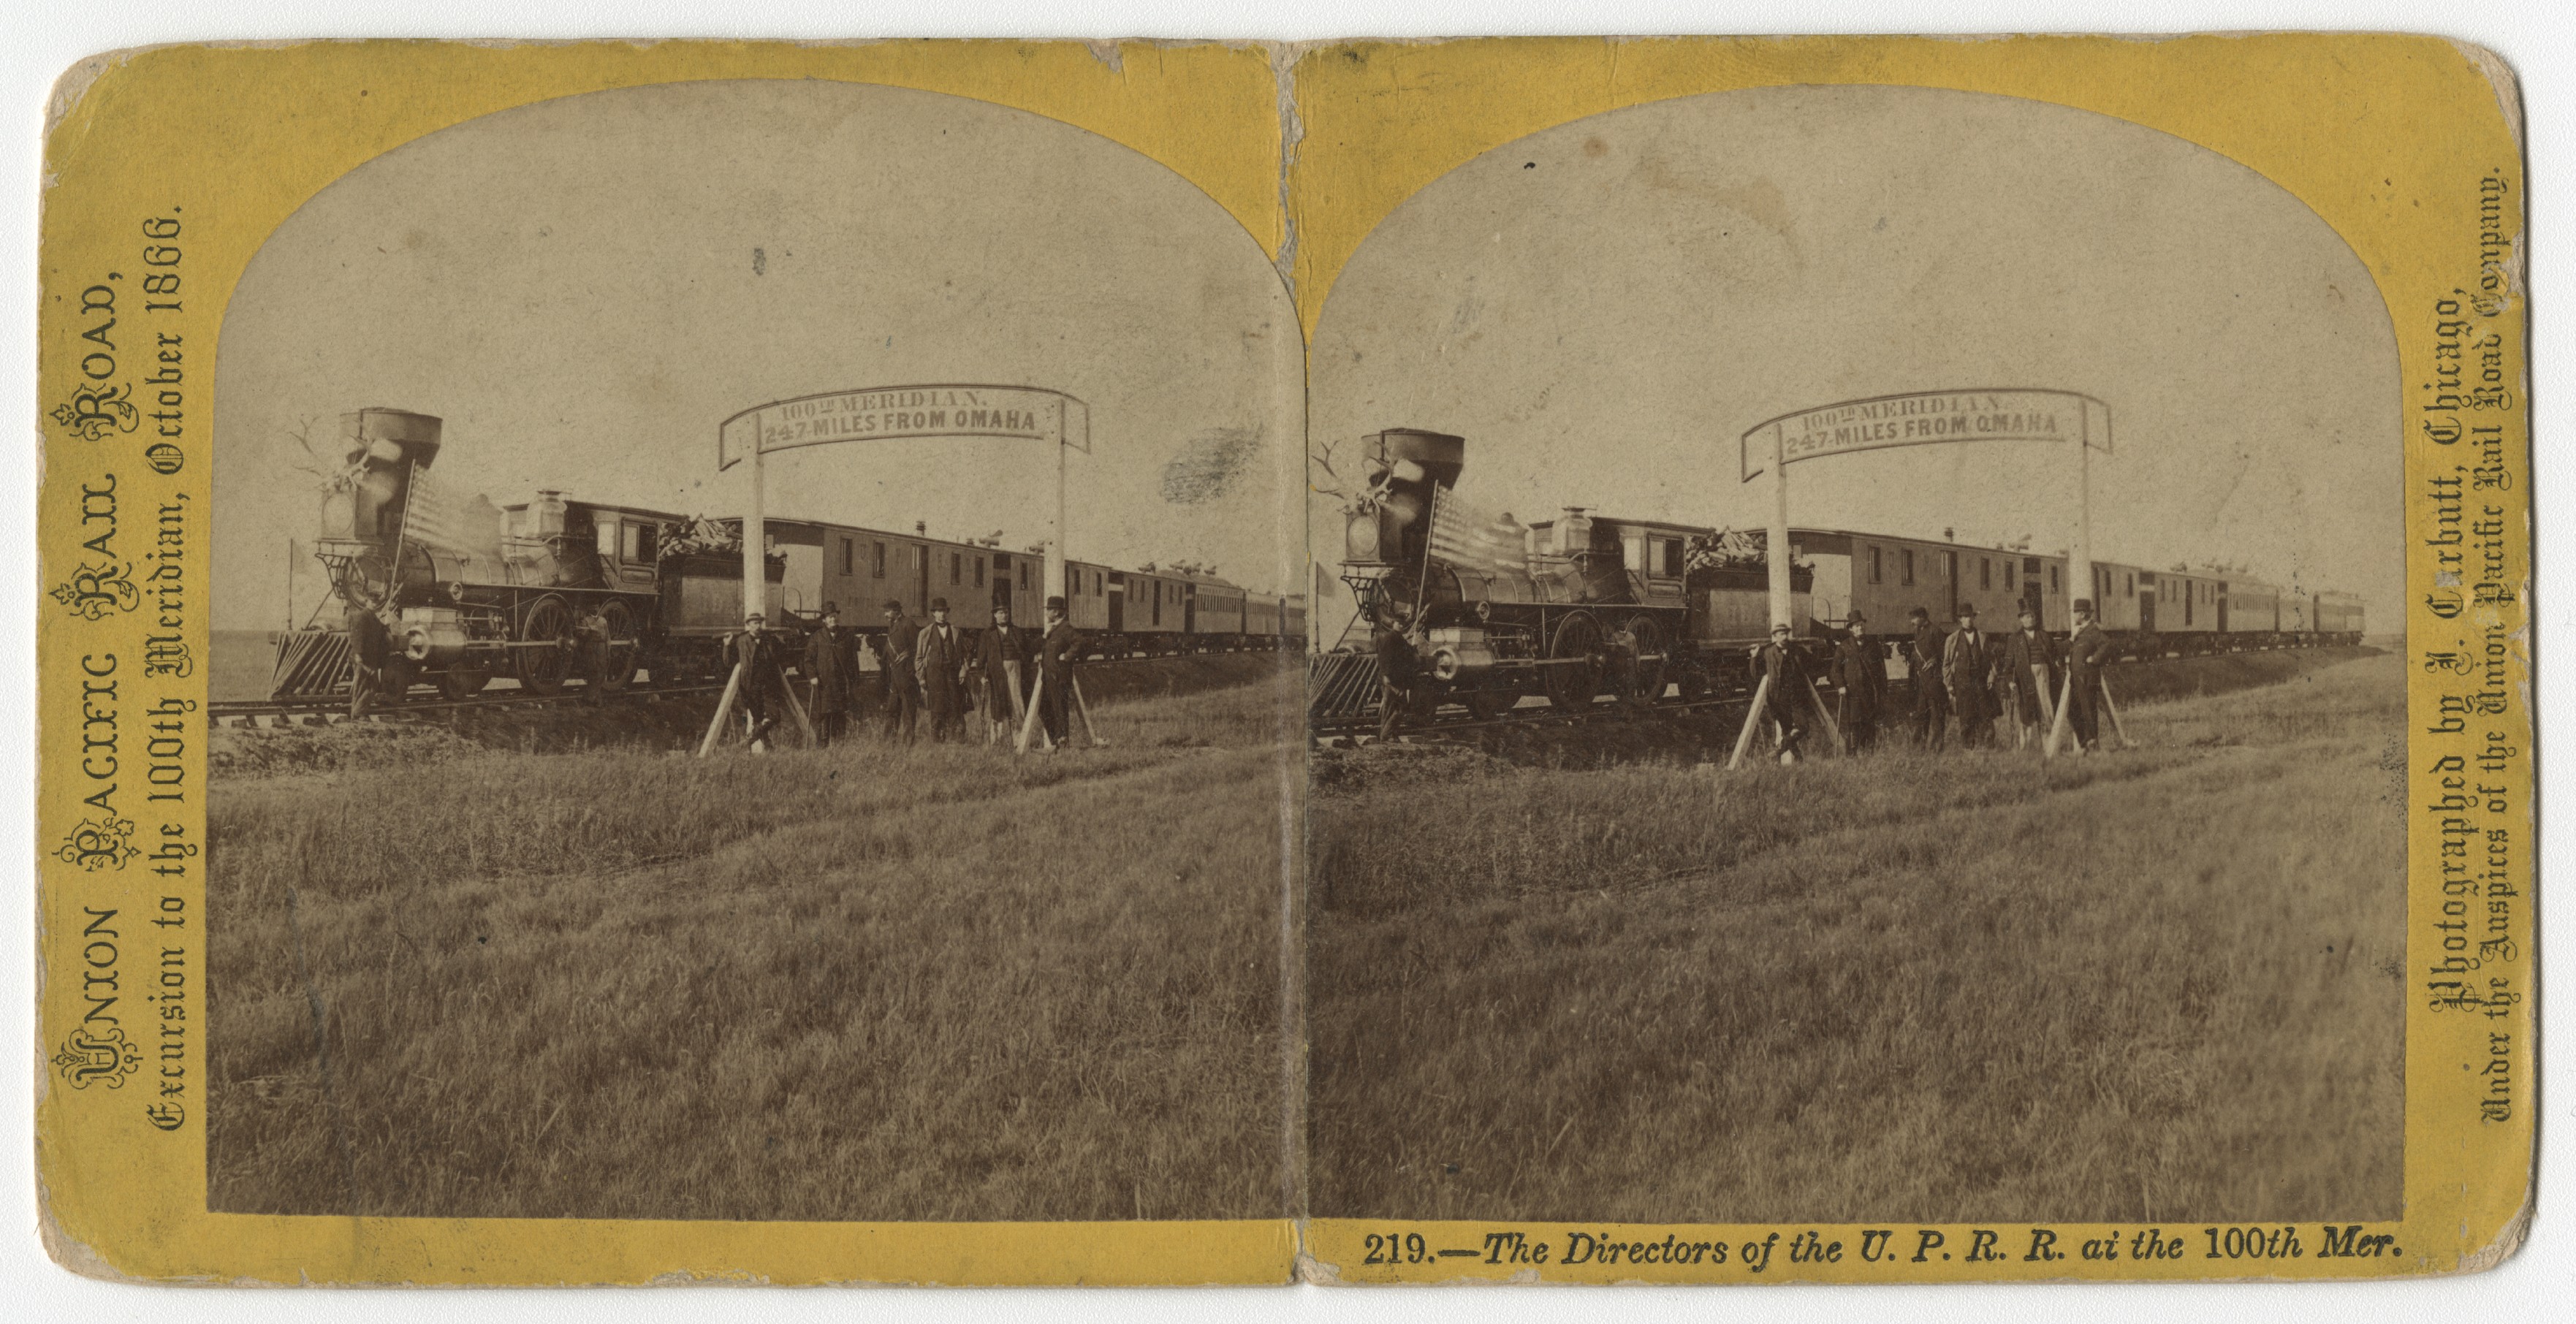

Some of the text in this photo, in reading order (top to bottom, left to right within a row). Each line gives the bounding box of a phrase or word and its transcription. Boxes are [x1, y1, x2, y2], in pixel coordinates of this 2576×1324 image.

[2423, 286, 2472, 446] Chicago,
[2471, 332, 2512, 411] Road
[884, 410, 946, 431] FROM
[954, 409, 1036, 430] OMAHA
[1904, 416, 1967, 438] FROM
[1975, 413, 2058, 434] OMAHA
[2472, 423, 2512, 492] Rail
[2473, 504, 2515, 608] Pacific
[143, 205, 197, 1132] Excursion to the 100th Meridian, October 1866.
[2474, 621, 2507, 715] Union
[2427, 693, 2475, 735] by
[2475, 730, 2517, 771] the
[2476, 782, 2507, 813] of
[2425, 754, 2480, 1012] Photographed
[2478, 827, 2518, 963] Auspices
[2480, 976, 2521, 1020] the
[2480, 1031, 2512, 1123] Under
[1560, 1232, 1728, 1264] Directors
[1741, 1232, 1779, 1273] of
[1790, 1230, 1842, 1263] the
[1861, 1230, 1896, 1262] U.
[1911, 1230, 1950, 1263] P.
[1965, 1230, 2006, 1262] R.
[2024, 1229, 2065, 1261] R.
[2131, 1228, 2184, 1260] the
[2205, 1227, 2303, 1259] 100th
[2317, 1225, 2403, 1258] Mer.
